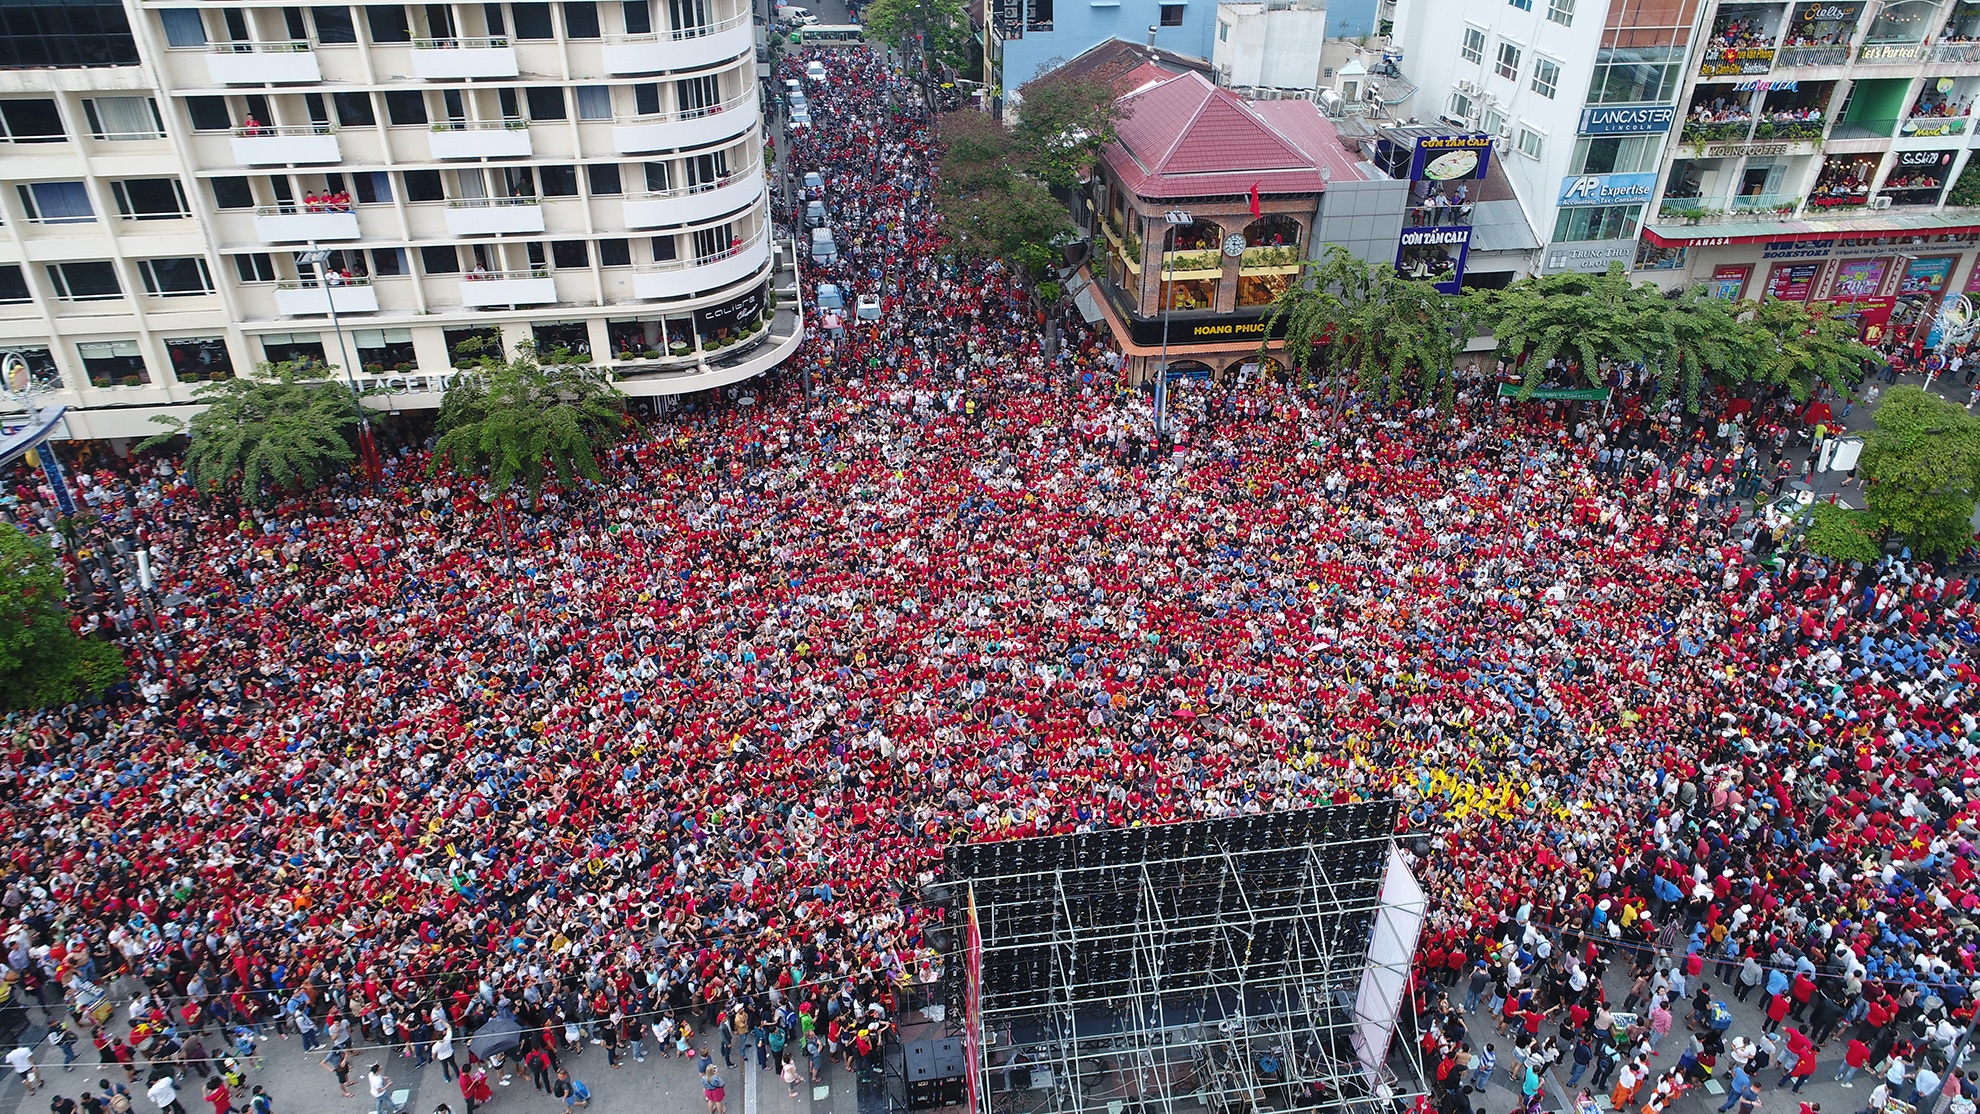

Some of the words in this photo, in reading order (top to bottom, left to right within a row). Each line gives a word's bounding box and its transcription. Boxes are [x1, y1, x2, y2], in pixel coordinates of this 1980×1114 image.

[1591, 109, 1673, 124] LANCASTER
[1605, 124, 1653, 132] LINCOLN
[1466, 138, 1490, 147] CALI
[1748, 145, 1788, 155] COFFEE
[1600, 184, 1650, 197] Expertise
[1614, 196, 1648, 204] Consulting
[1444, 231, 1469, 243] CALI
[1688, 237, 1731, 247] FAHASA
[1569, 249, 1604, 260] TRUNG
[1762, 249, 1831, 259] BOOKSTORE
[1581, 260, 1611, 268] GROU
[1193, 324, 1233, 336] HOANG
